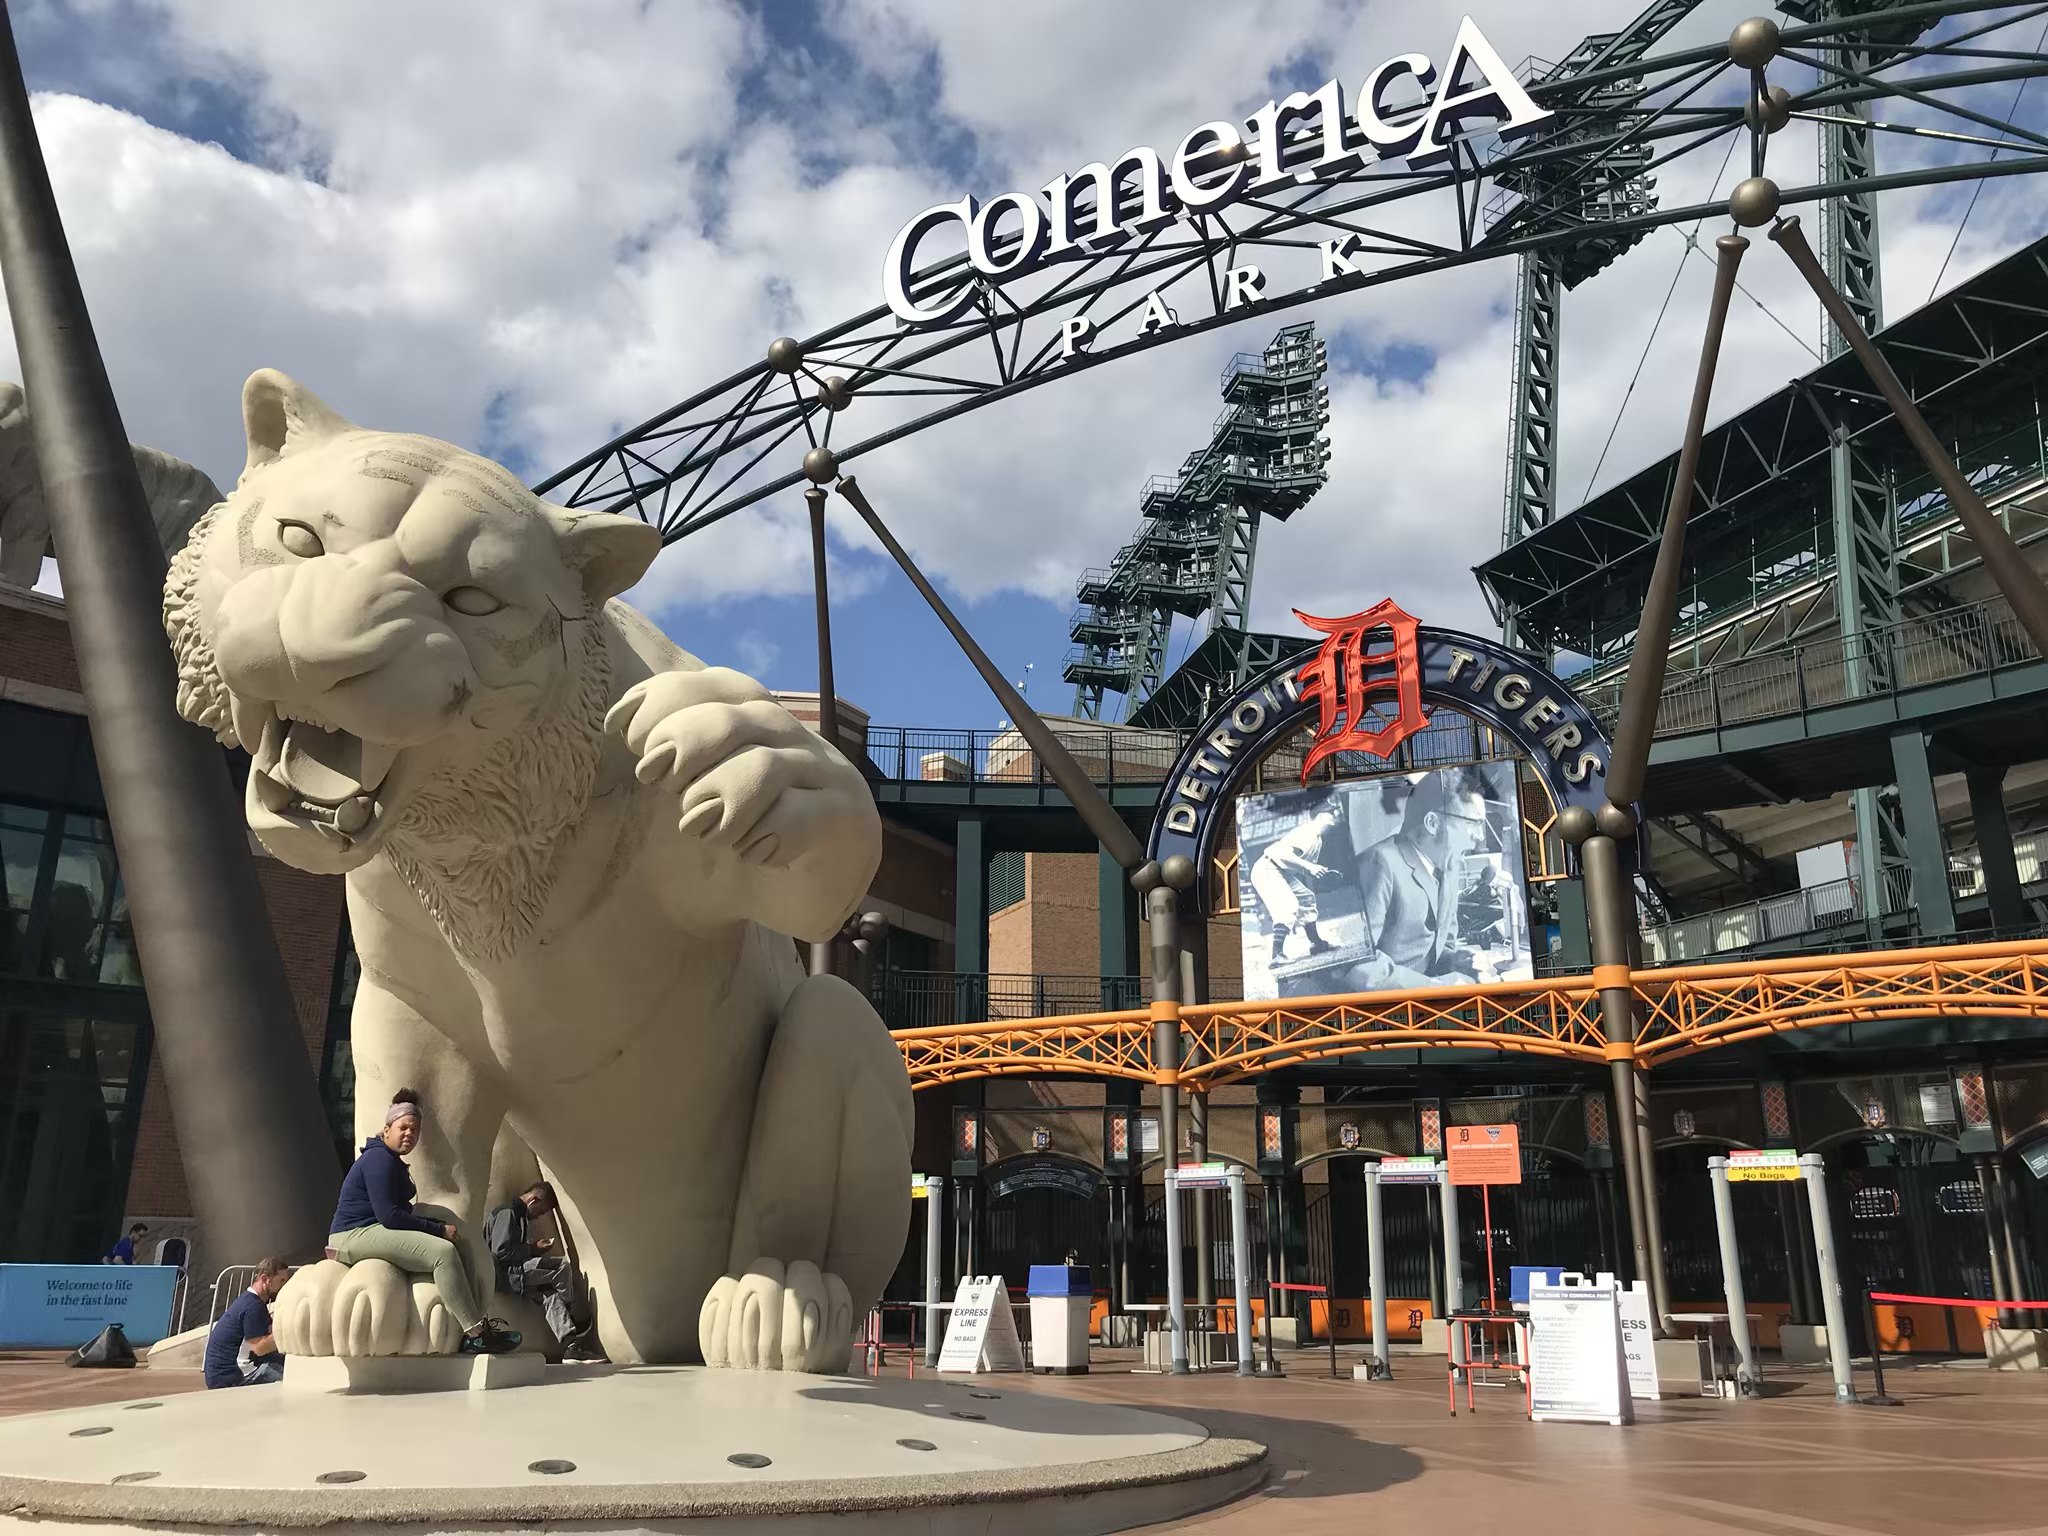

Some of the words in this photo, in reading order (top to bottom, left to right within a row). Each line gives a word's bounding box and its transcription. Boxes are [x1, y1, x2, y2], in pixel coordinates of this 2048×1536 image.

[1060, 231, 1364, 360] PARK
[1445, 647, 1602, 785] TIGERS
[1164, 668, 1302, 835] DETROIT
[47, 1279, 99, 1290] Welcome
[102, 1281, 113, 1290] to
[114, 1279, 133, 1290] life
[47, 1294, 58, 1305] in
[60, 1294, 80, 1305] the
[80, 1294, 102, 1305] fast
[103, 1294, 128, 1305] lane
[954, 1308, 989, 1316] EXPRESS
[960, 1319, 978, 1327] LINE
